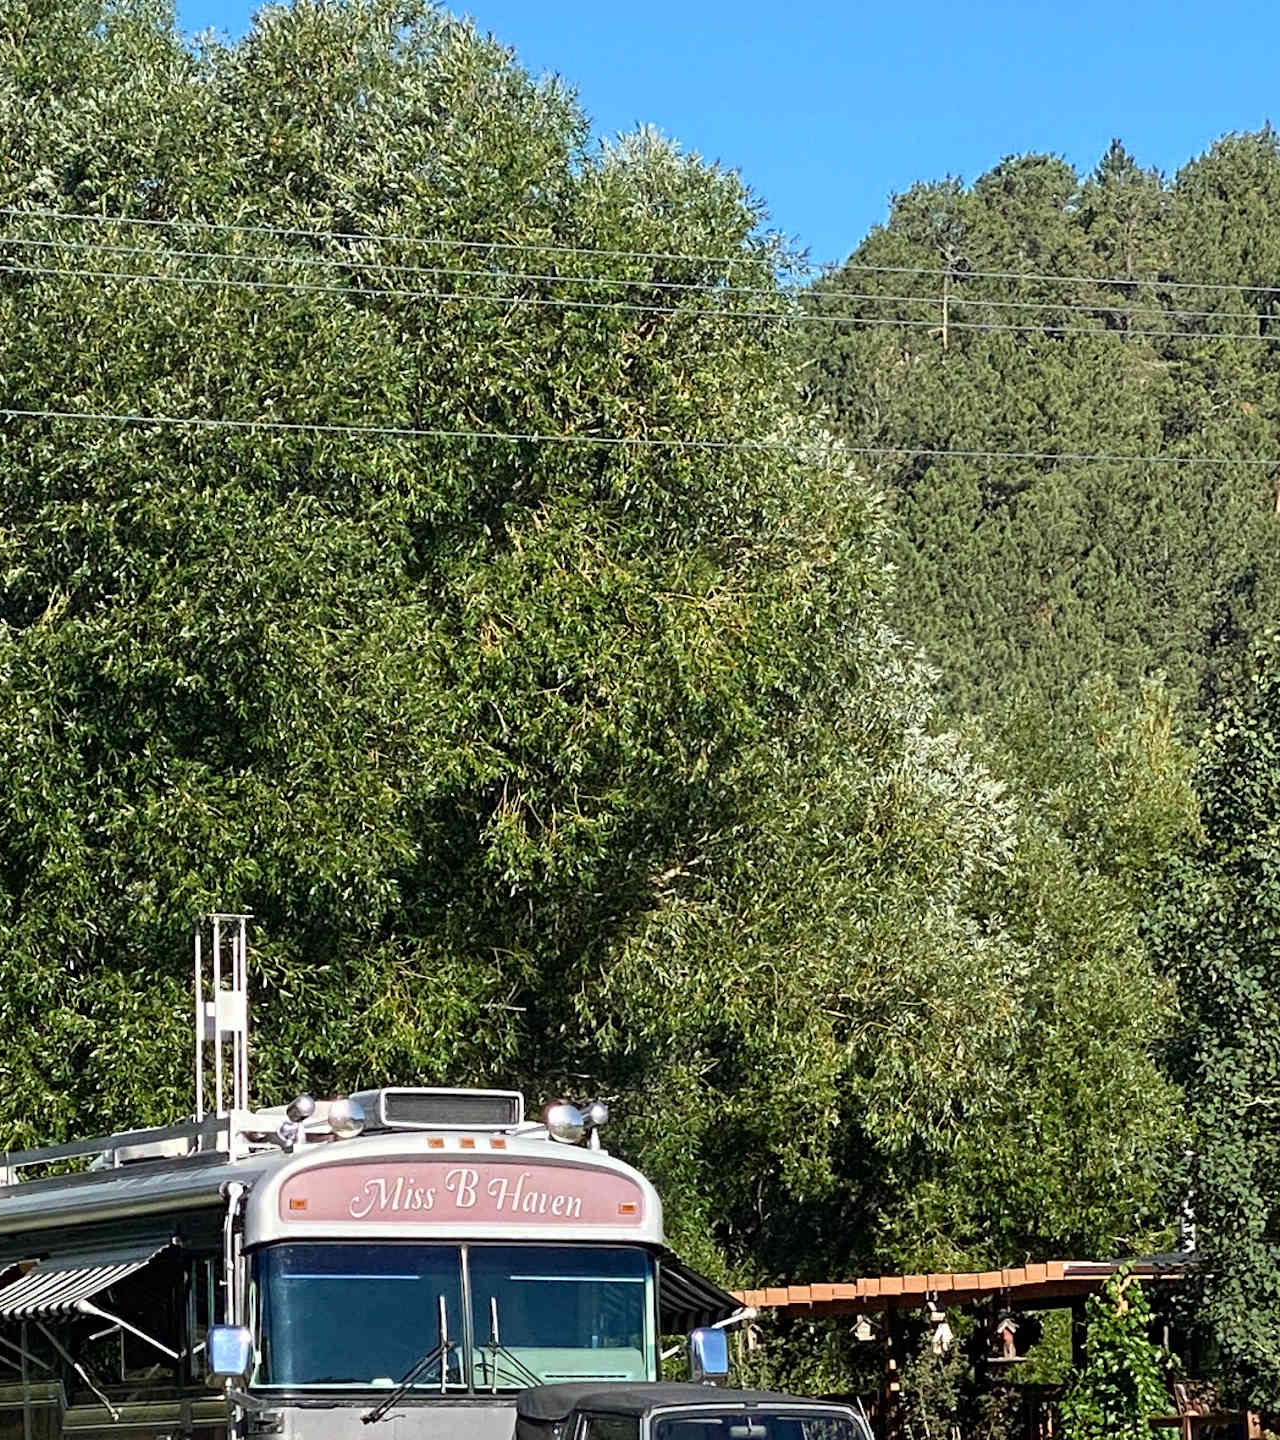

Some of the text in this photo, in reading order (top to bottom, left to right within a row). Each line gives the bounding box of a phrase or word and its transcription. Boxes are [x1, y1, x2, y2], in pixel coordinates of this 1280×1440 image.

[349, 1168, 584, 1218] Miss B Haven
